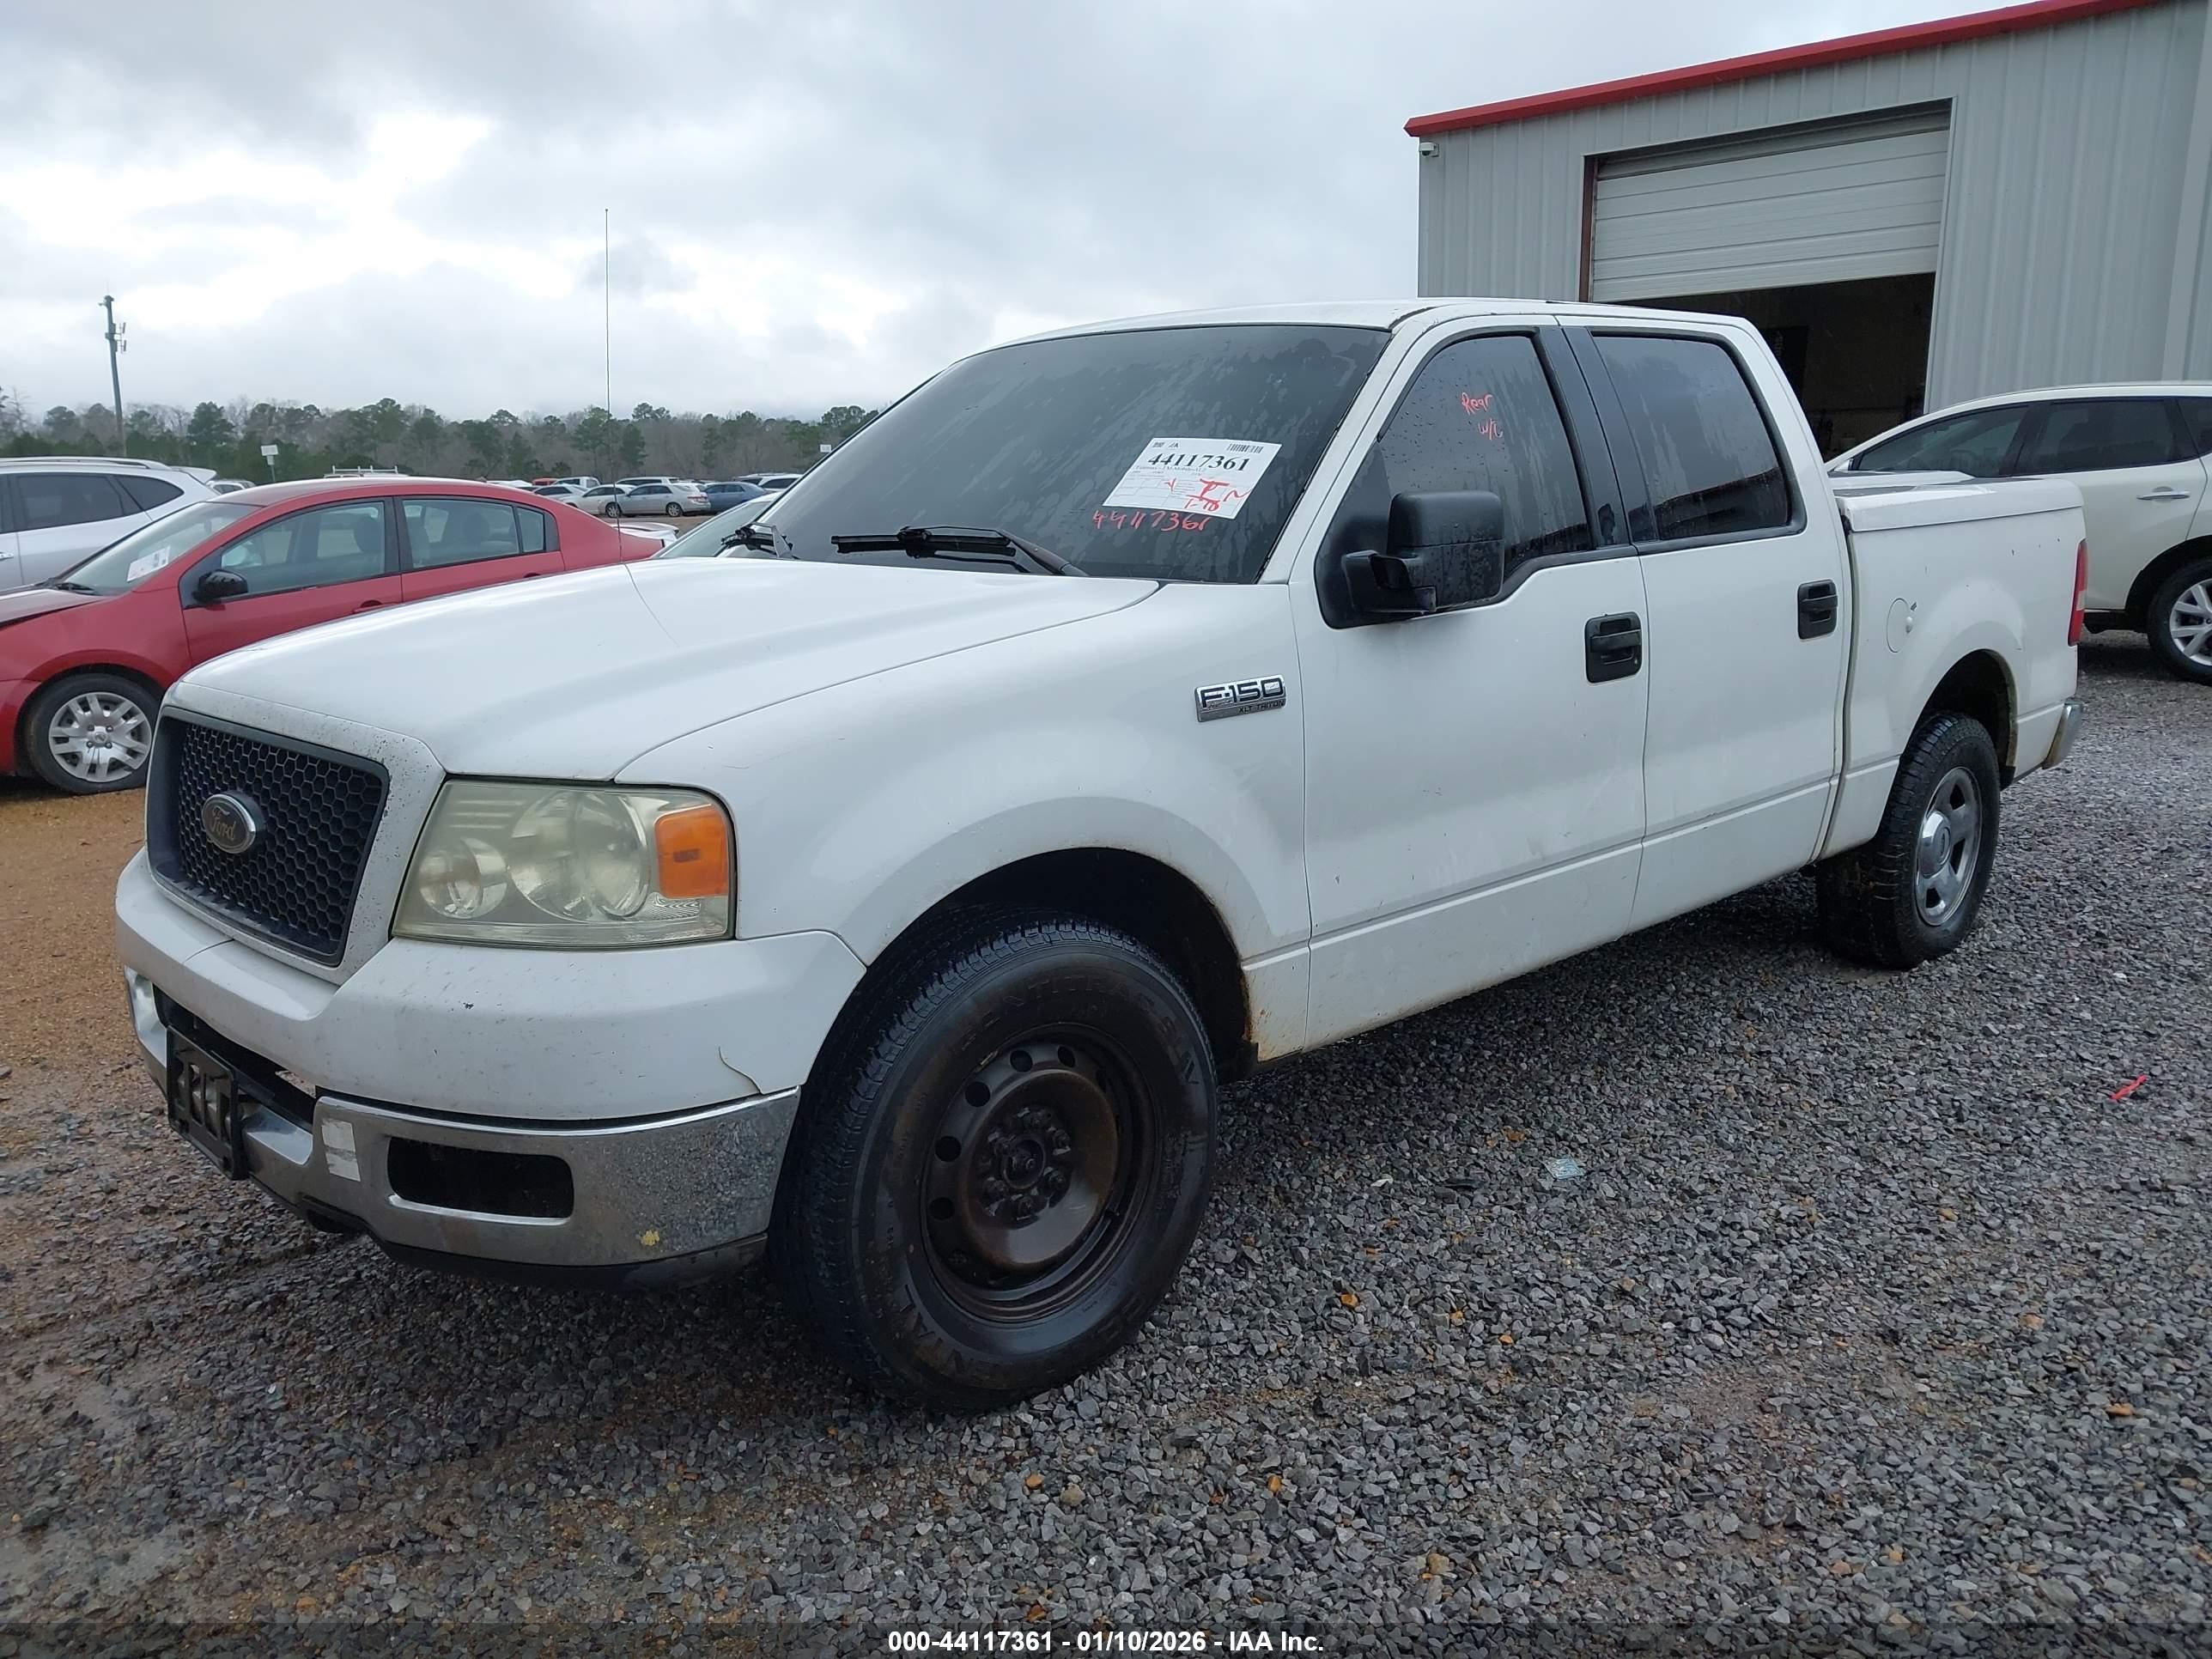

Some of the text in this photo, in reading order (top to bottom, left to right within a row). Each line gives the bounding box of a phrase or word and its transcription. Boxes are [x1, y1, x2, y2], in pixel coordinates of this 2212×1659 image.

[1147, 453, 1251, 472] 44117361
[1238, 699, 1285, 714] XLT TRITON
[210, 805, 238, 842] Ford
